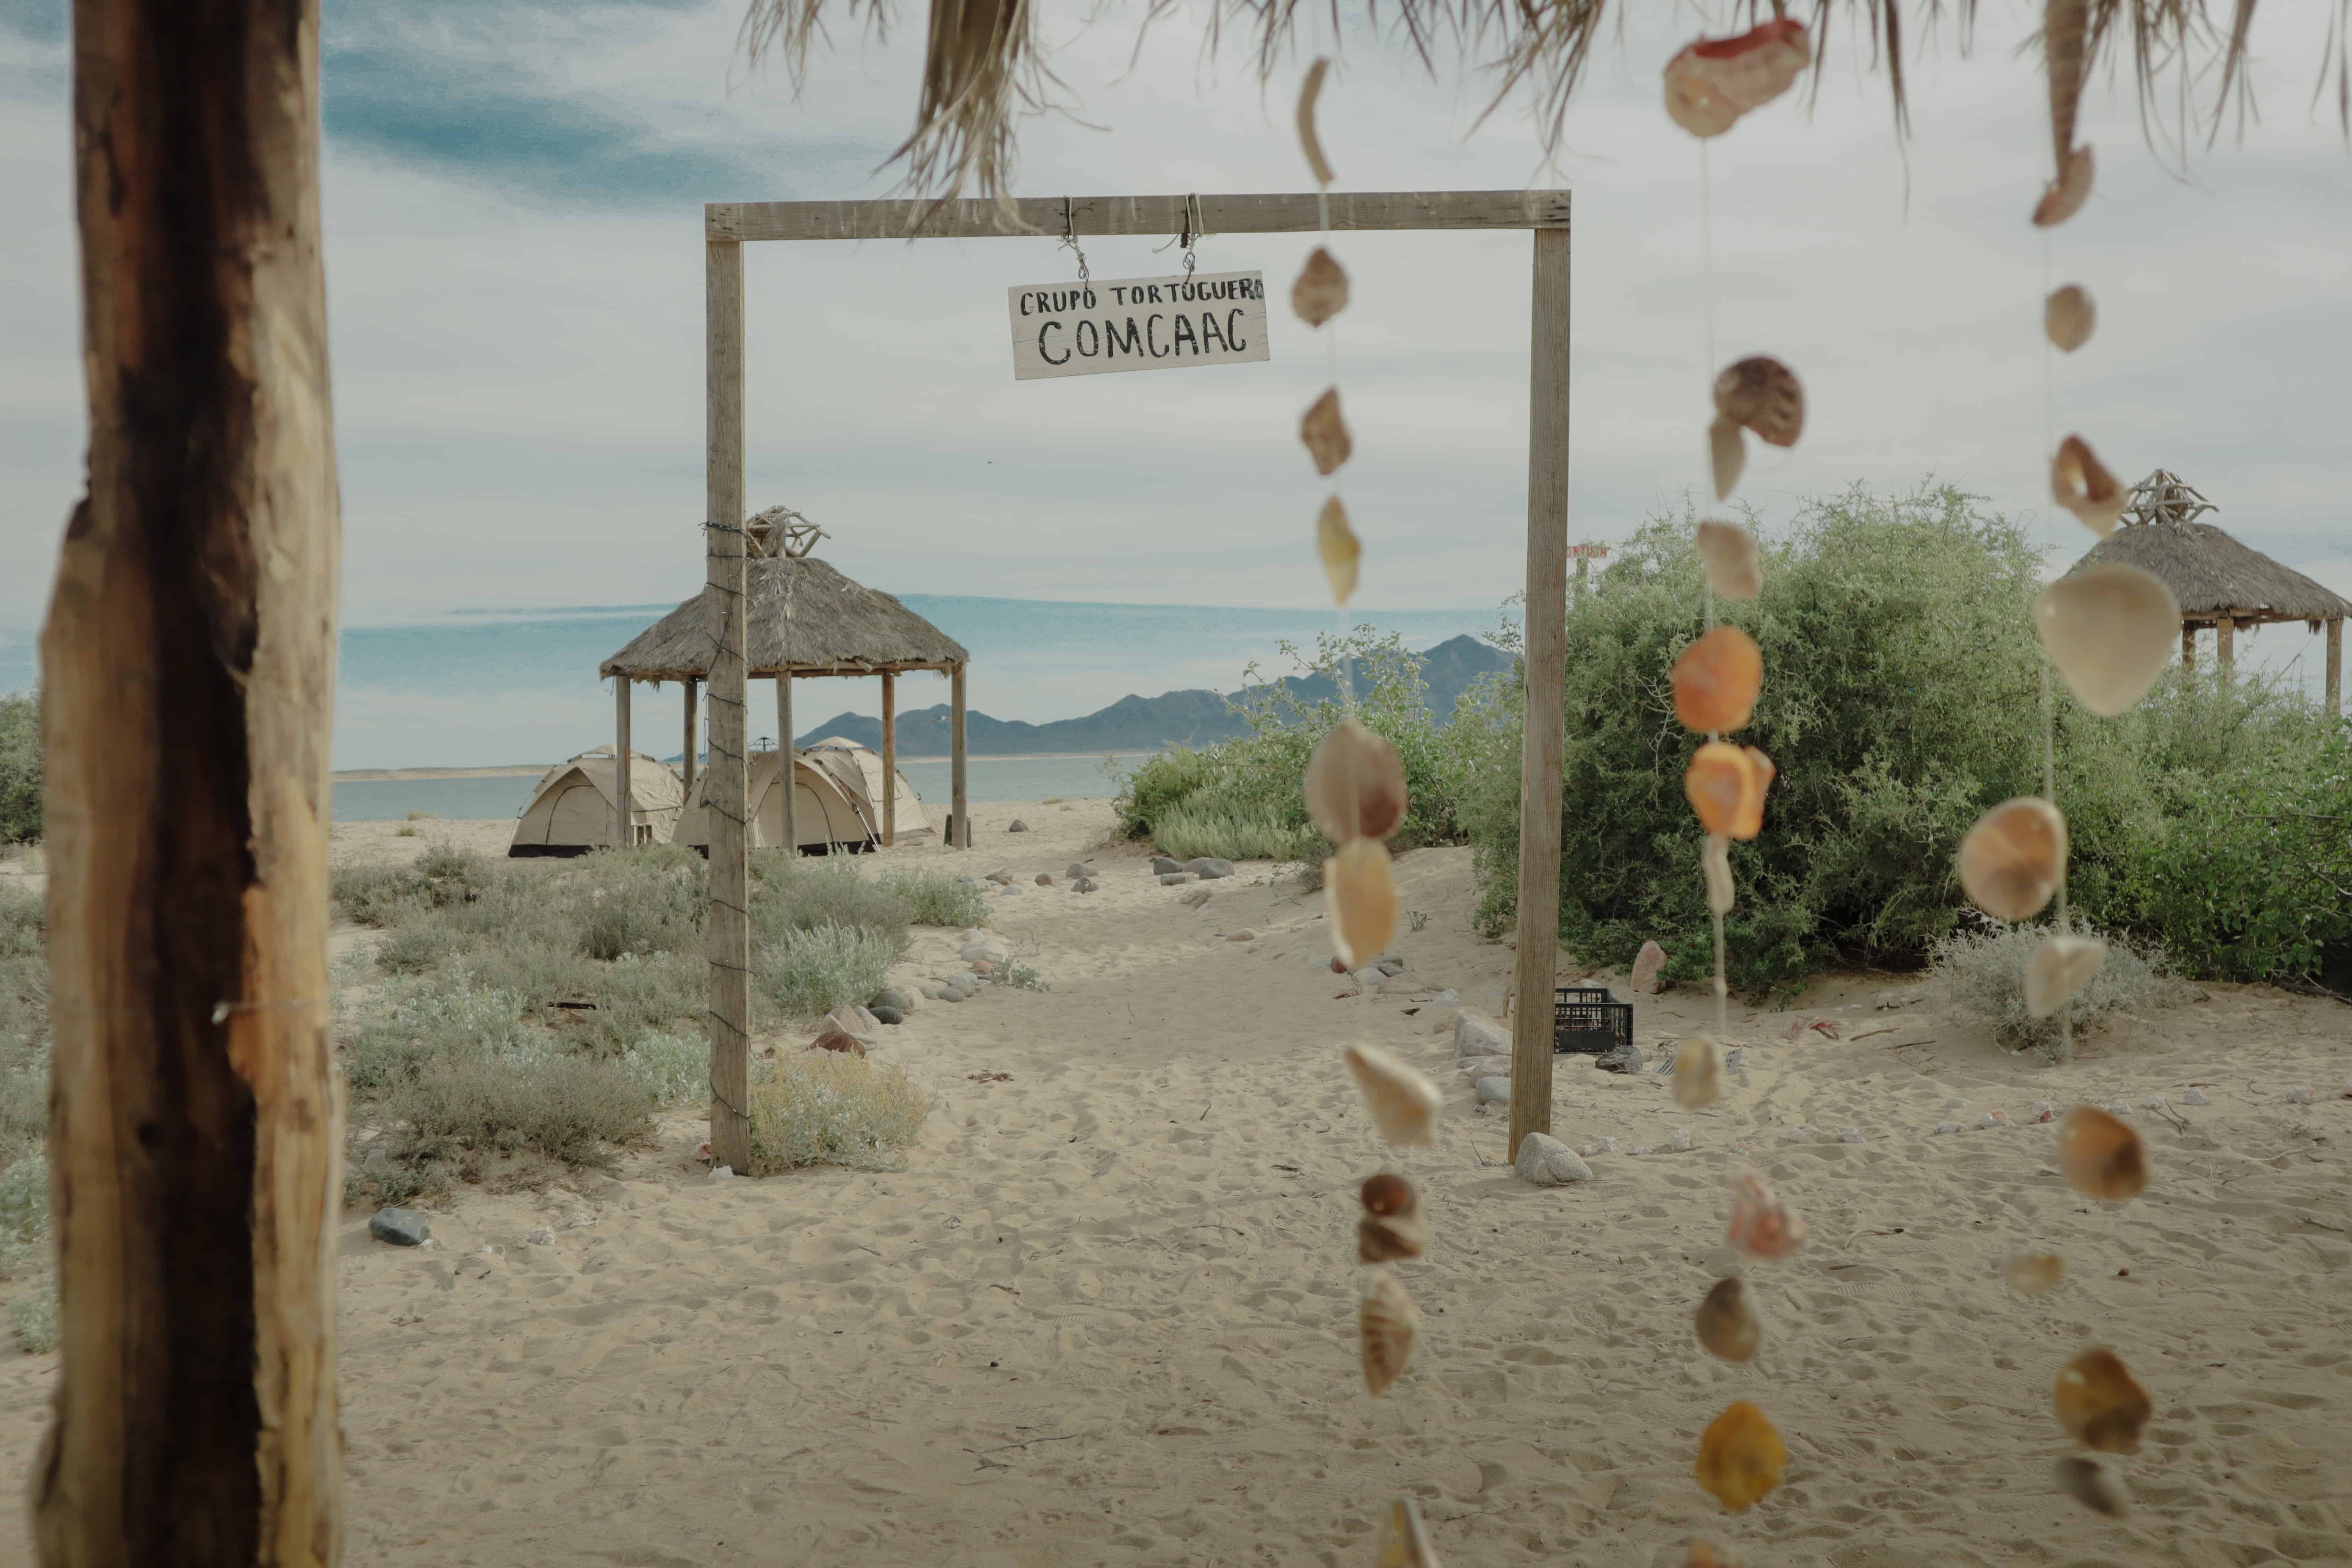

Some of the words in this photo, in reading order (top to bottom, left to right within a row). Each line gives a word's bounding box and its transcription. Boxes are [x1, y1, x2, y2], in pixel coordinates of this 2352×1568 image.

[1020, 289, 1096, 316] GRUPO
[1109, 278, 1264, 306] TORTUGUERO
[1039, 309, 1246, 365] COMCAAC
